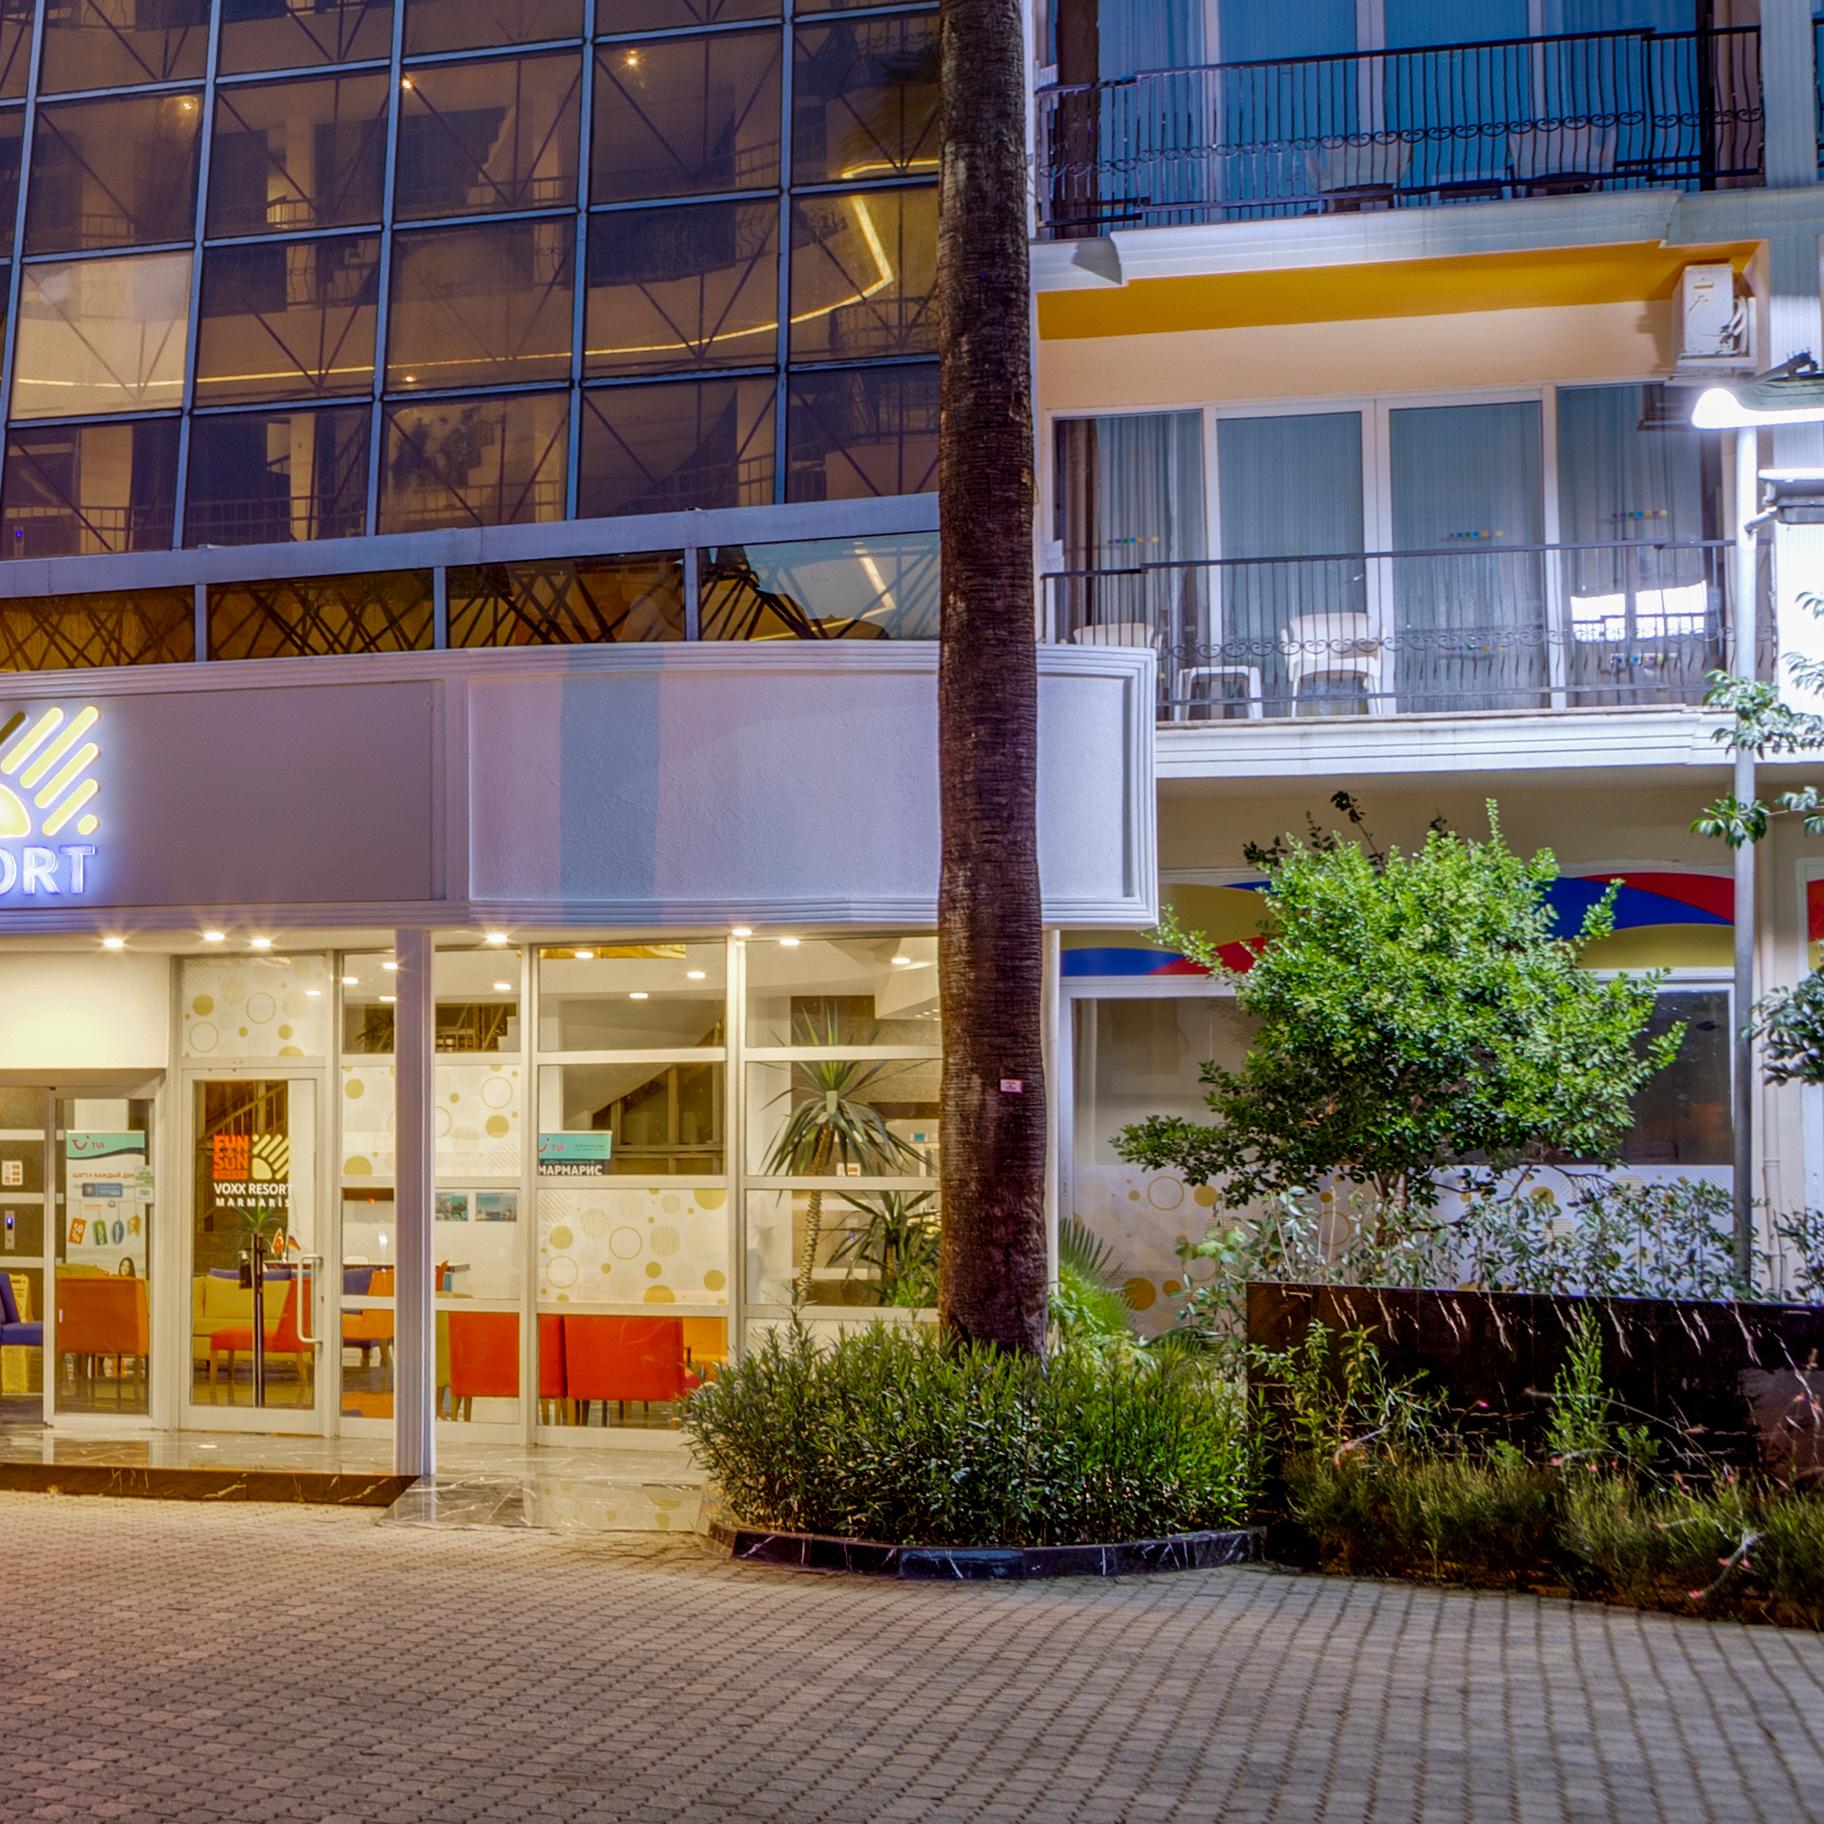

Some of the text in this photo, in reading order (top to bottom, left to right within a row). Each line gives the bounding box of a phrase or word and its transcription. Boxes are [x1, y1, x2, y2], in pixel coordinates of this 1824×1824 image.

[213, 1135, 249, 1152] FUN
[214, 1154, 249, 1170] SUN
[213, 1182, 247, 1195] VOXX
